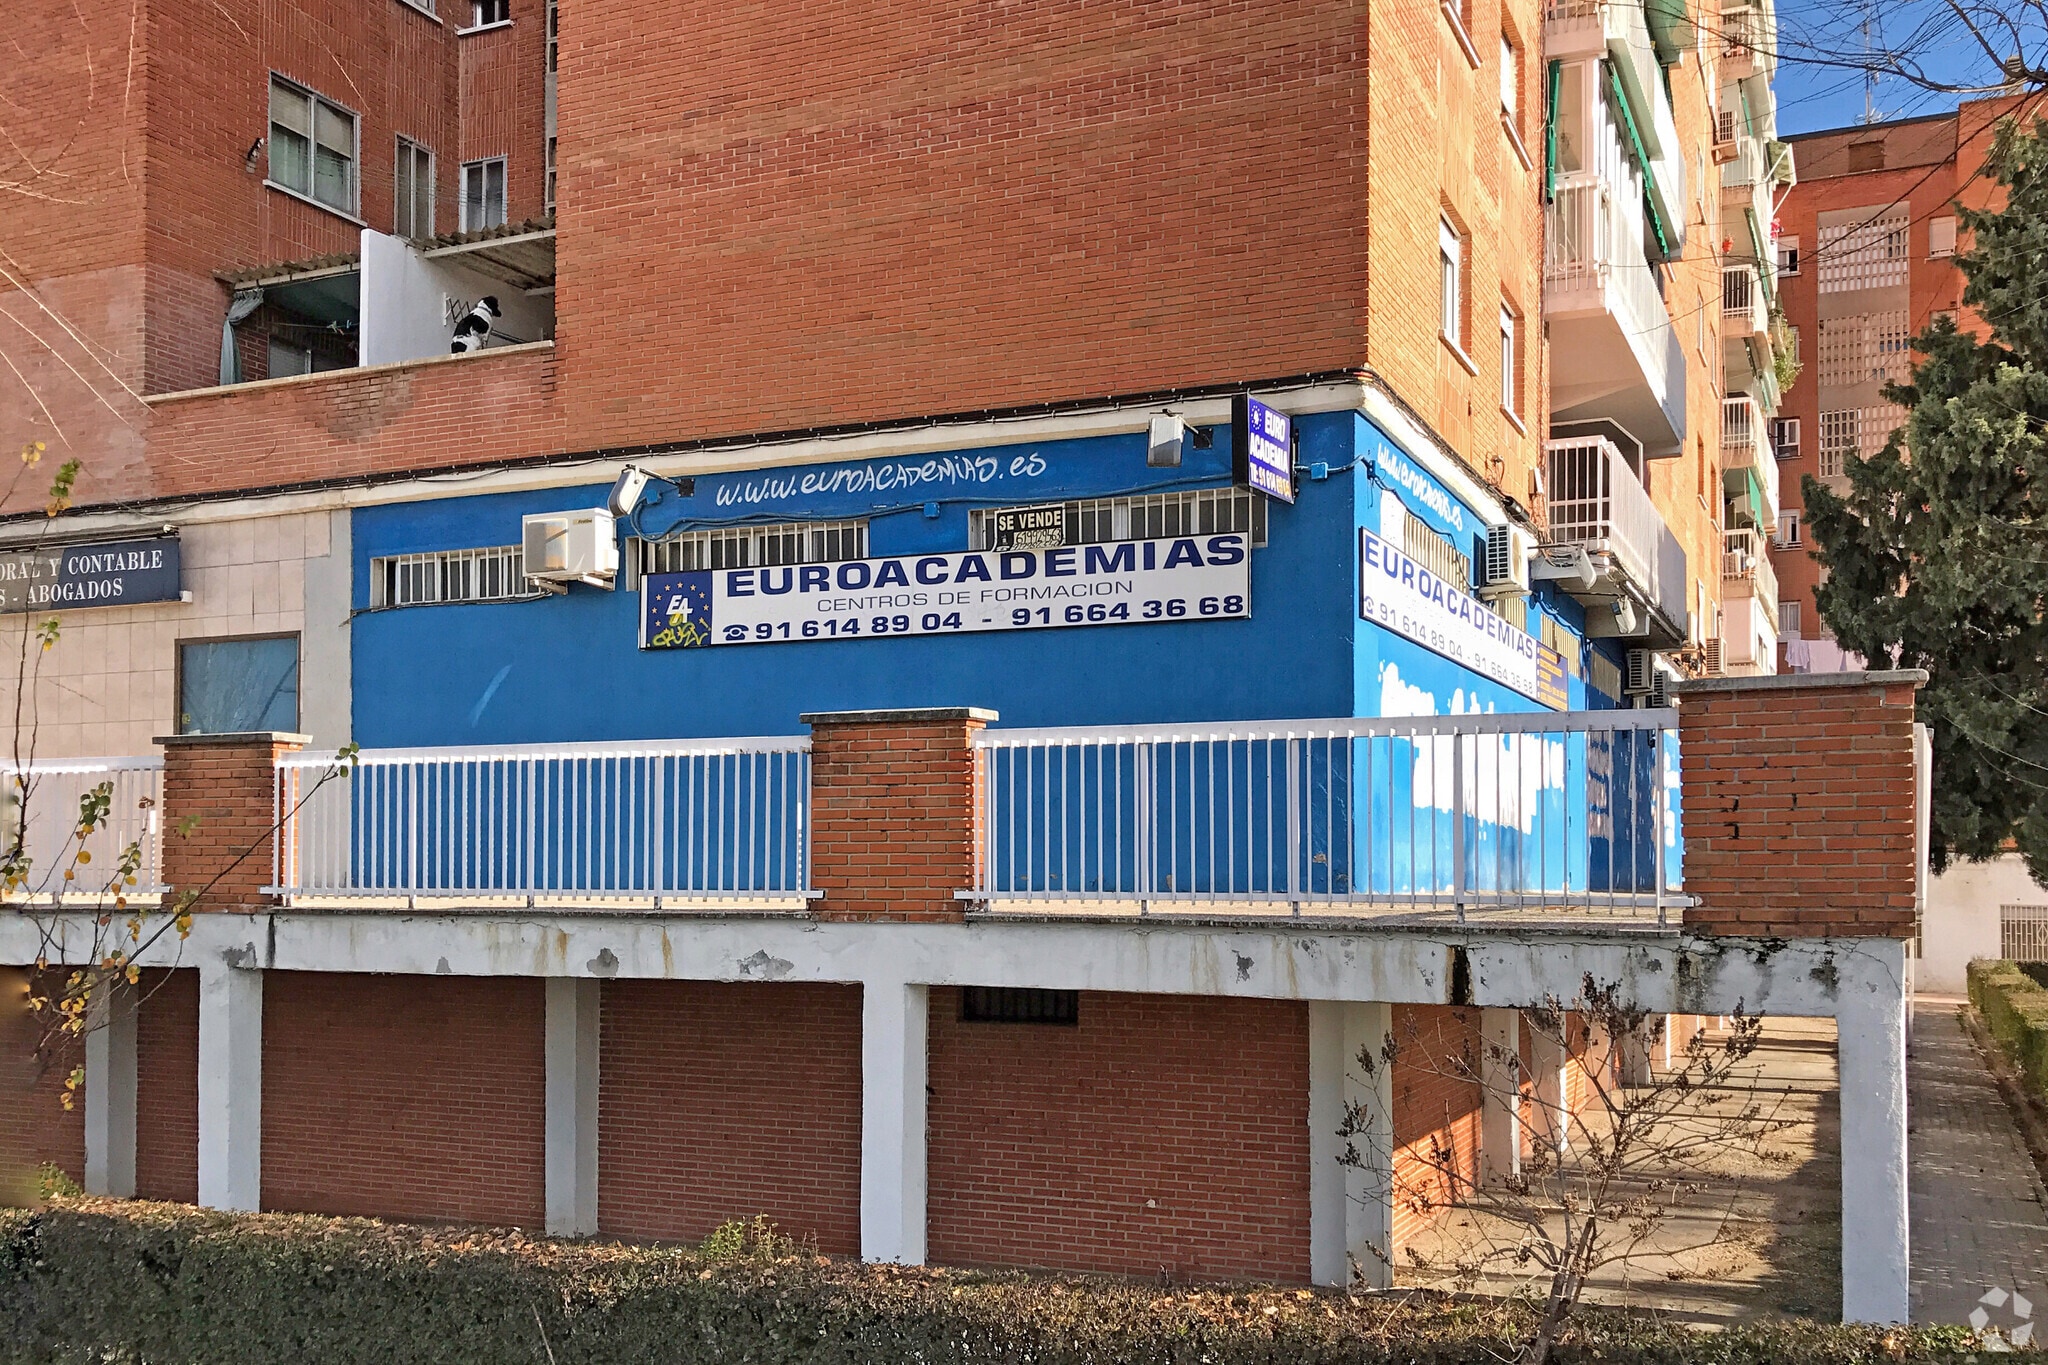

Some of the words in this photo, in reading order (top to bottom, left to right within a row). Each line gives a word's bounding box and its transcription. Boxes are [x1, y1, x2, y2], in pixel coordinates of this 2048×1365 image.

[1264, 410, 1286, 442] EURO
[1249, 432, 1289, 474] ACADEMIA
[998, 515, 1015, 532] SE
[1019, 510, 1062, 529] VENDE
[49, 558, 61, 577] Y
[68, 550, 163, 575] CONTABLE
[727, 535, 1245, 598] EUROACADEMIAS
[27, 577, 123, 604] ABOGADOS
[817, 592, 928, 612] CENTROS
[938, 591, 971, 606] DE
[980, 580, 1133, 603] FORMACION
[1364, 534, 1534, 660] EUROACADEMIAS
[755, 622, 791, 640] 91
[801, 618, 861, 637] 614
[871, 614, 910, 634] 89
[922, 611, 963, 631] 04
[1011, 606, 1051, 626] 91
[1064, 602, 1131, 624] 664
[1142, 598, 1187, 619] 36
[1199, 595, 1244, 615] 68
[1379, 602, 1397, 626] 91
[1402, 615, 1427, 641] 614
[1431, 630, 1445, 651] 89
[1449, 639, 1464, 660] 04
[1474, 653, 1487, 671] 91
[1491, 661, 1509, 682] 664
